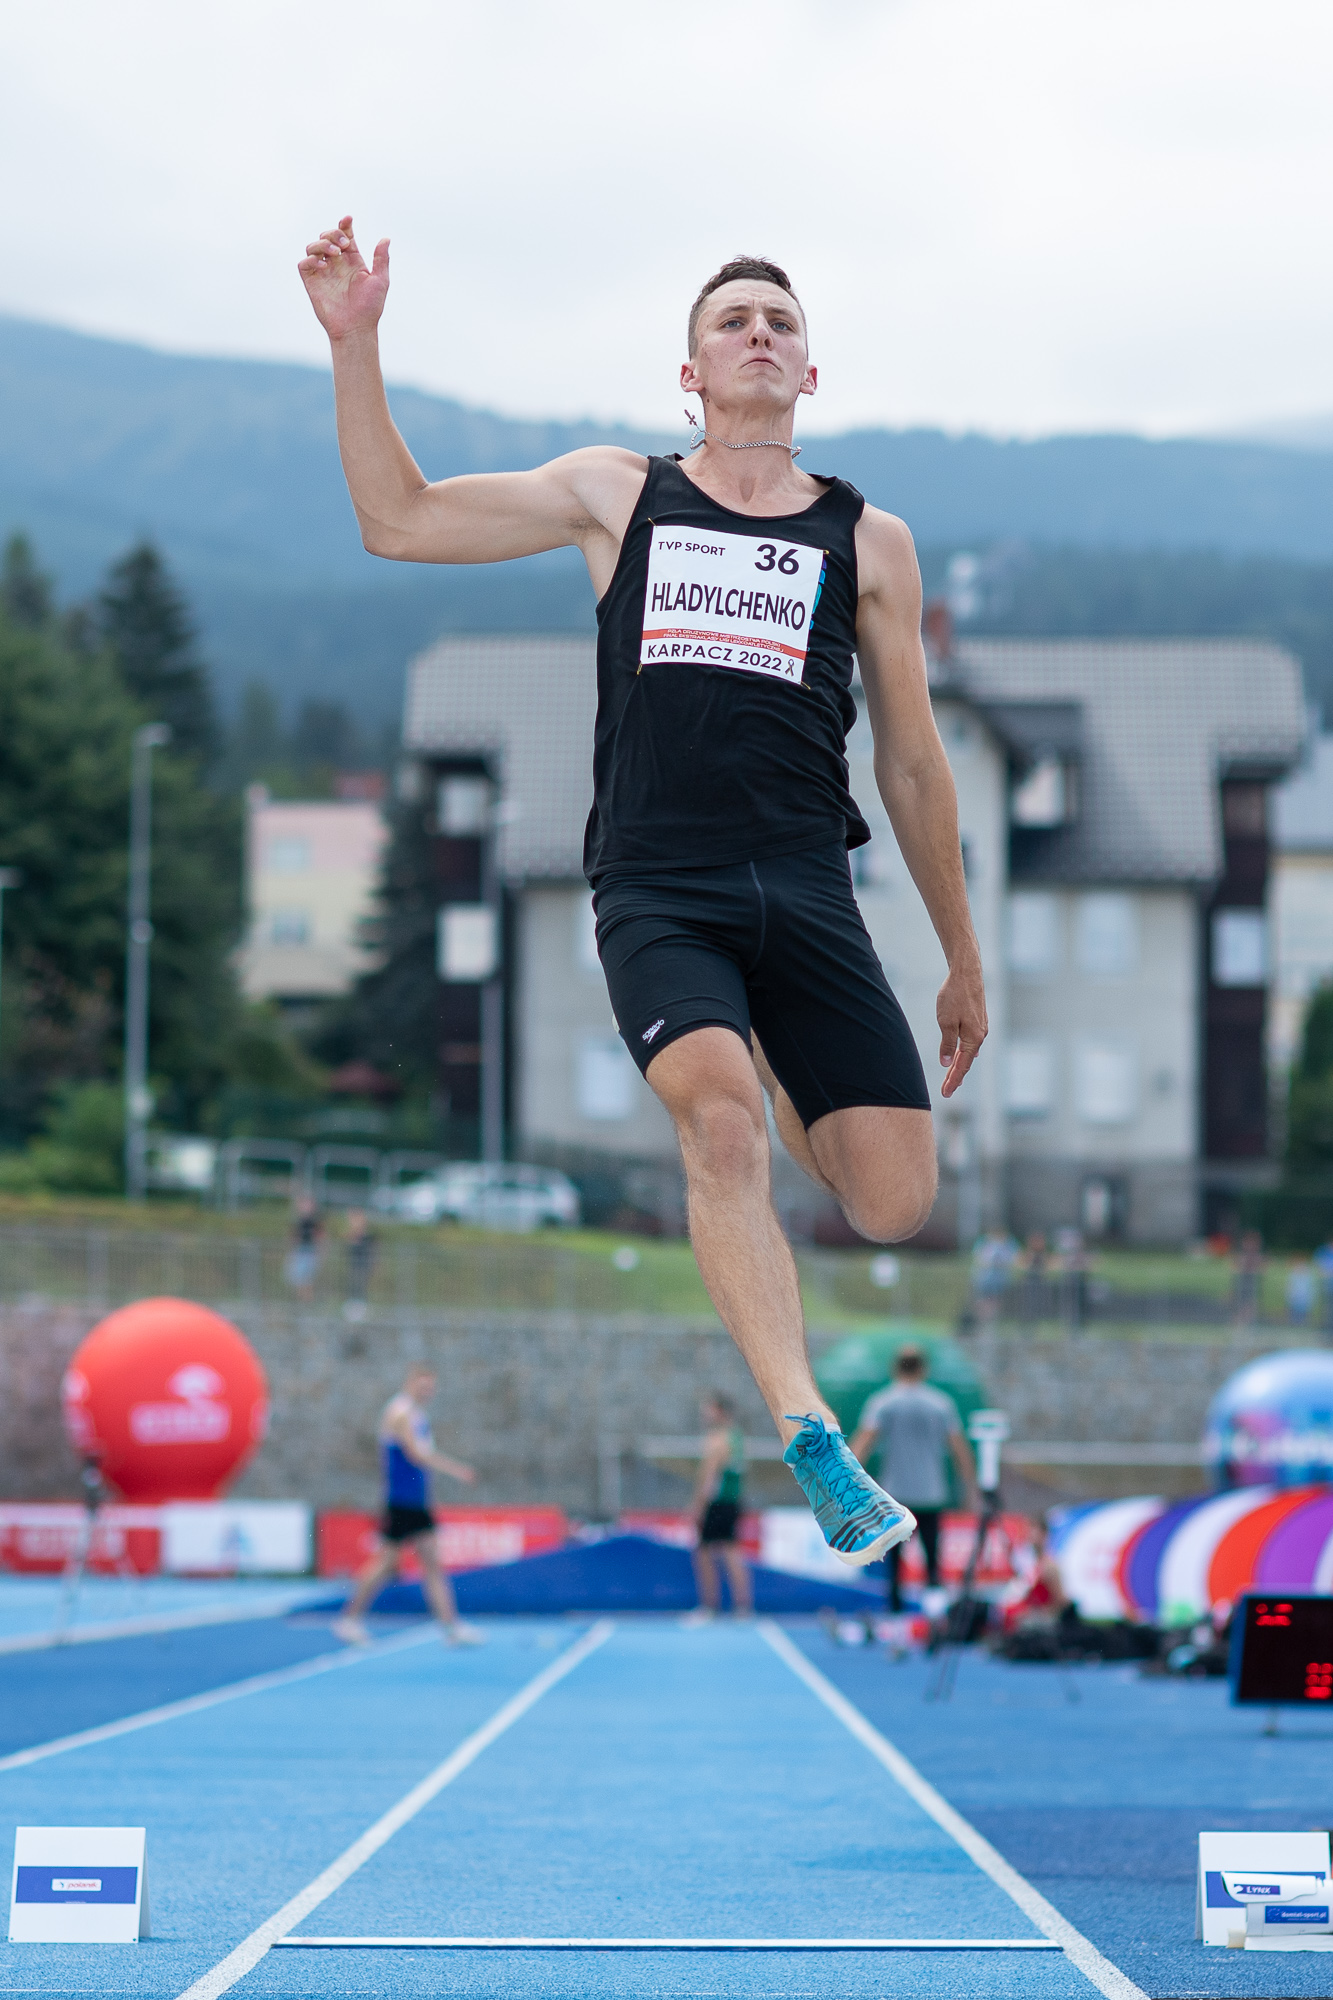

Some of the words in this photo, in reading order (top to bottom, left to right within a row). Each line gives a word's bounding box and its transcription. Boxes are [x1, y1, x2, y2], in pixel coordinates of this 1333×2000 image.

[658, 541, 682, 550] TVP
[685, 542, 726, 556] SPORT
[754, 543, 800, 575] 36
[651, 582, 806, 631] HLADYLCHENKO
[647, 643, 734, 662] KARPACZ
[738, 651, 782, 671] 2022
[1246, 1886, 1271, 1894] LYNX
